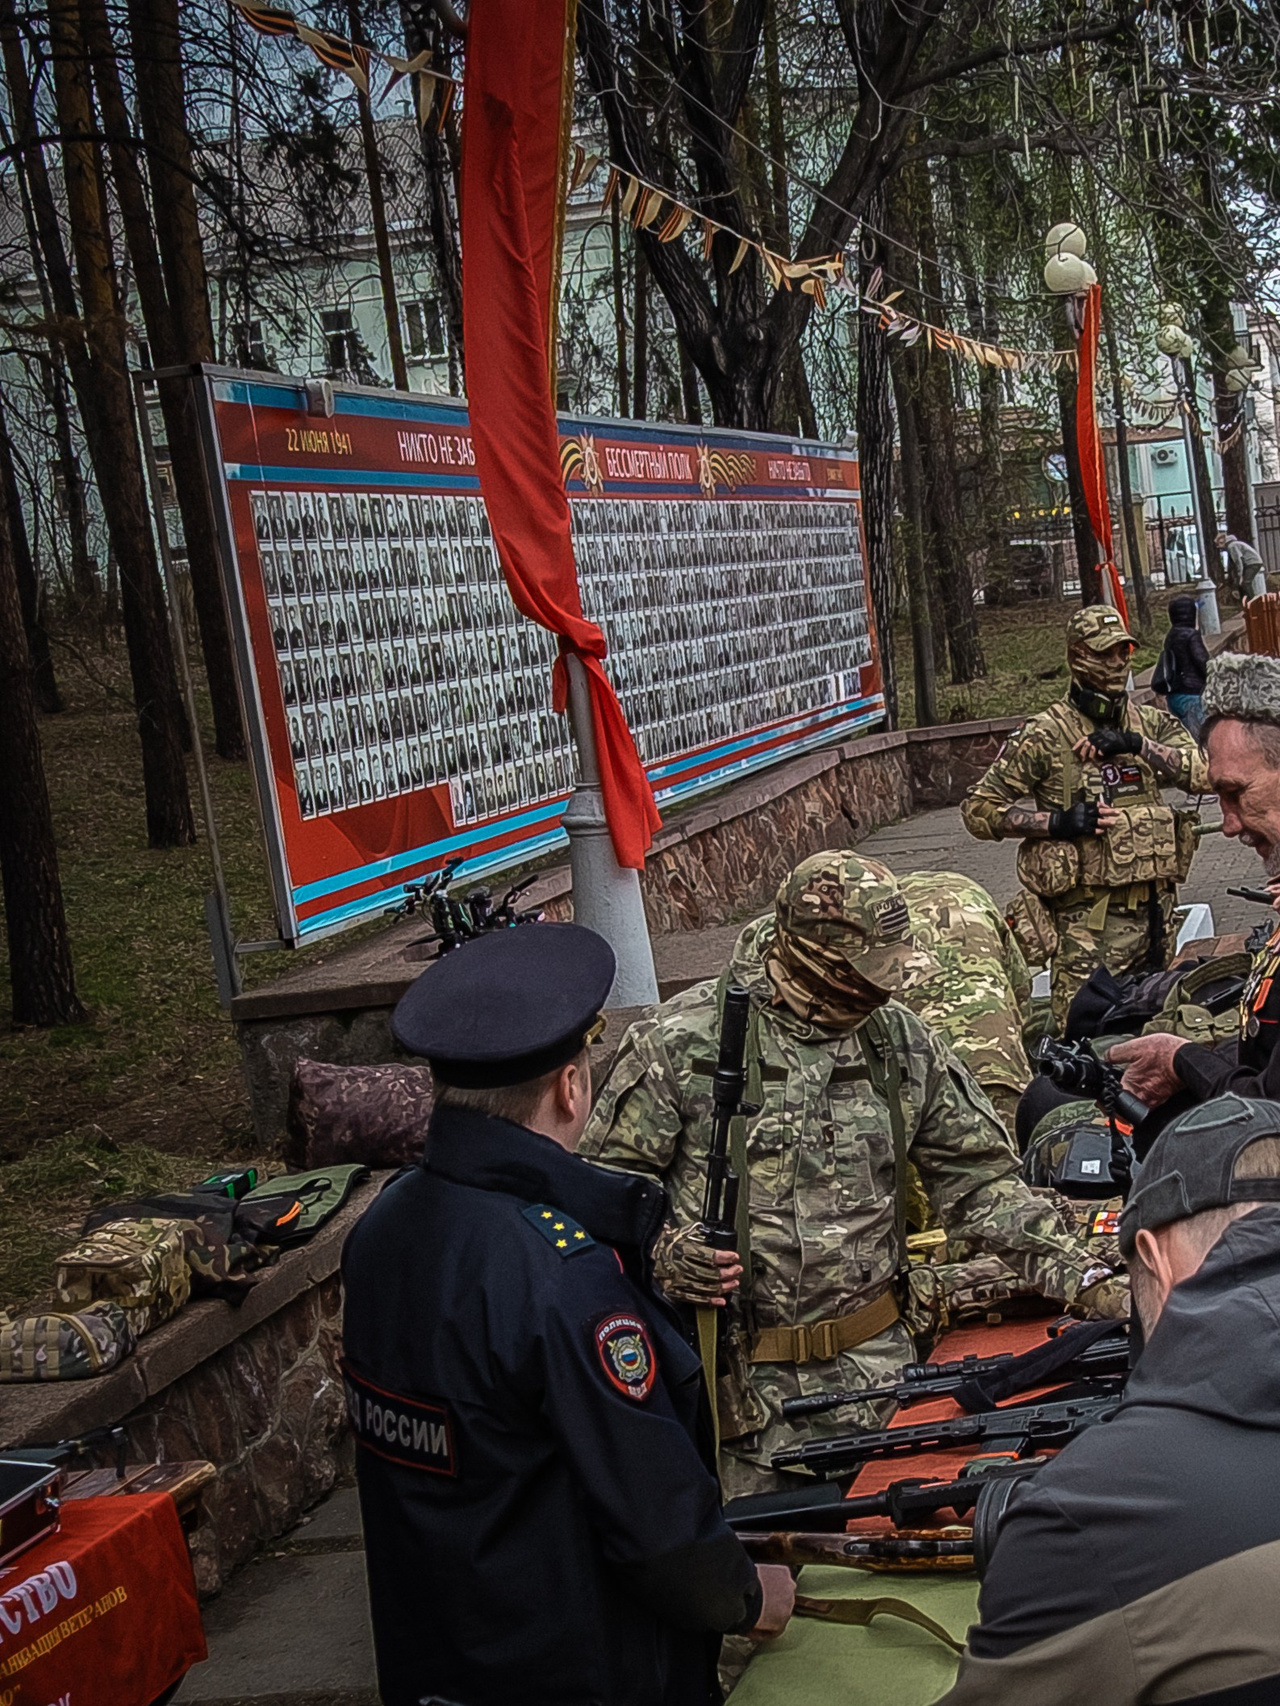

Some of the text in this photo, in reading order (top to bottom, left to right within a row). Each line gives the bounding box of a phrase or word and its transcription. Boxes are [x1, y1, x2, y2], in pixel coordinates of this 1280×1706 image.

[285, 428, 353, 456] 22 ИЮНЯ 1941
[396, 430, 438, 464] НИКТО
[439, 435, 456, 465] НЕ
[605, 445, 693, 481] БЕССМЕРТНЫЙ ПОЛК
[366, 1398, 448, 1457] РОССИИ
[0, 1560, 77, 1643] СТВО
